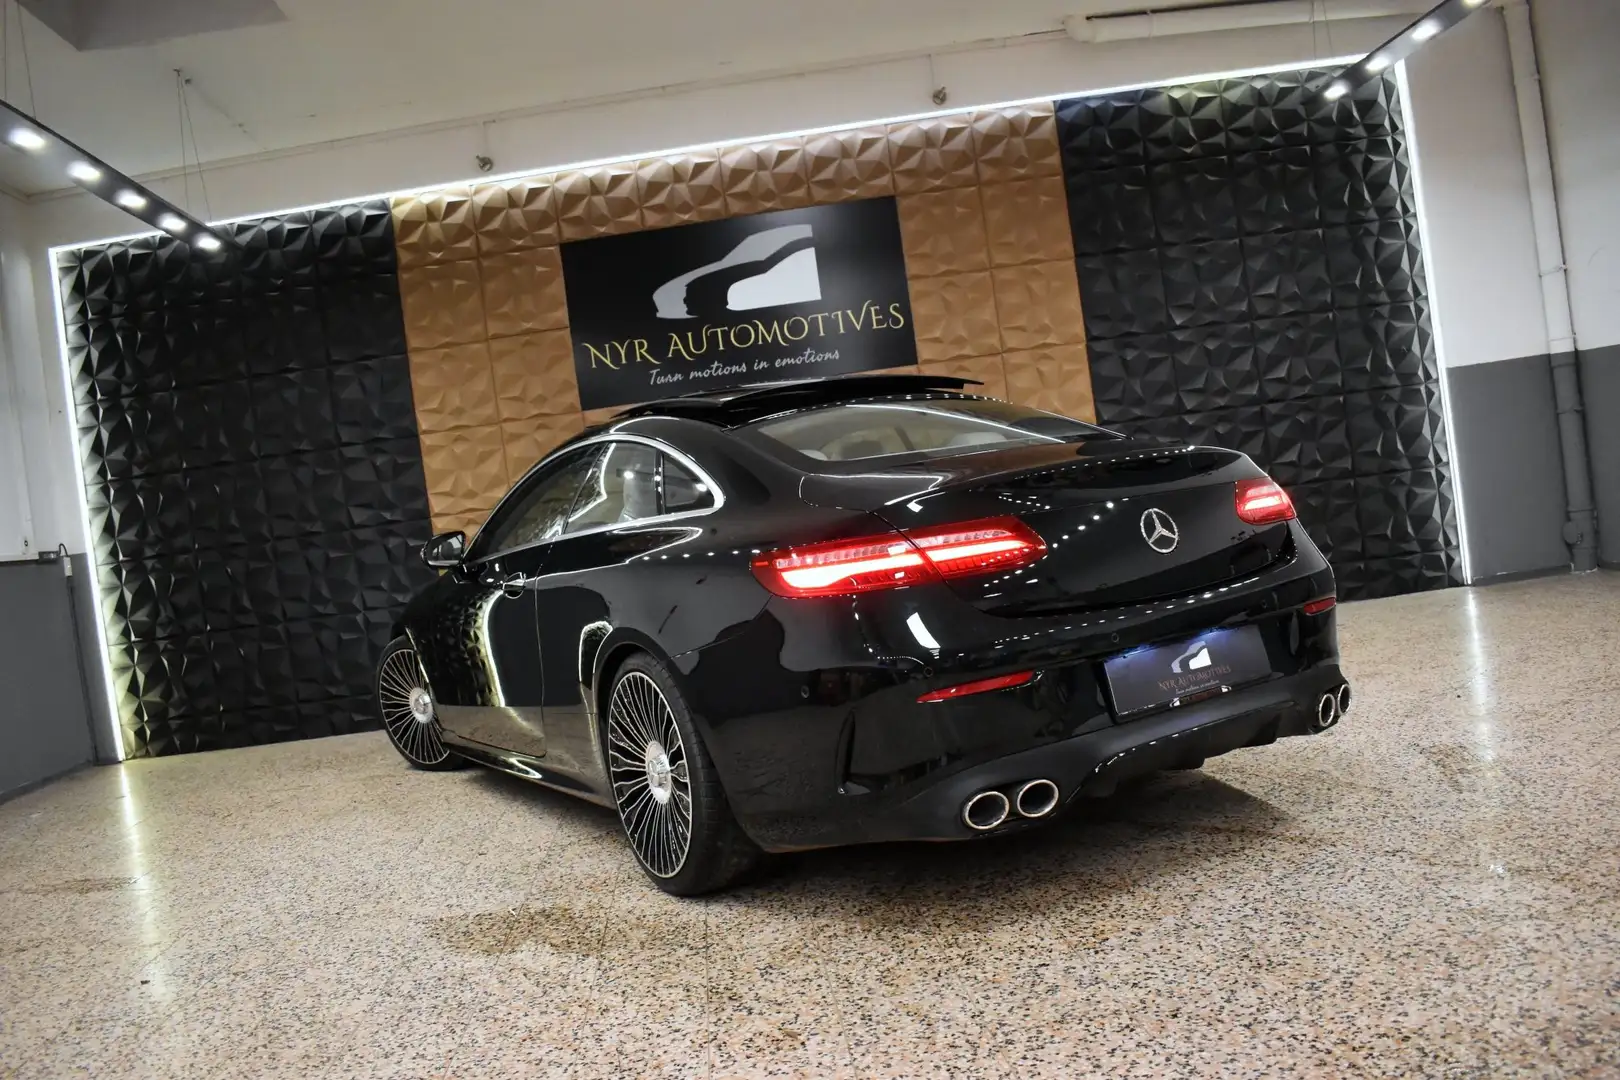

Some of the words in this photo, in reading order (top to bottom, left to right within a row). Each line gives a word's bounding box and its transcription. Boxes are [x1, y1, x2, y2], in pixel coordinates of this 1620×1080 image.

[582, 338, 662, 370] NYR
[667, 300, 905, 361] AUTOMOTIVES
[649, 368, 684, 386] Turn
[689, 359, 747, 380] motions
[754, 358, 770, 371] in
[774, 347, 840, 369] emotions
